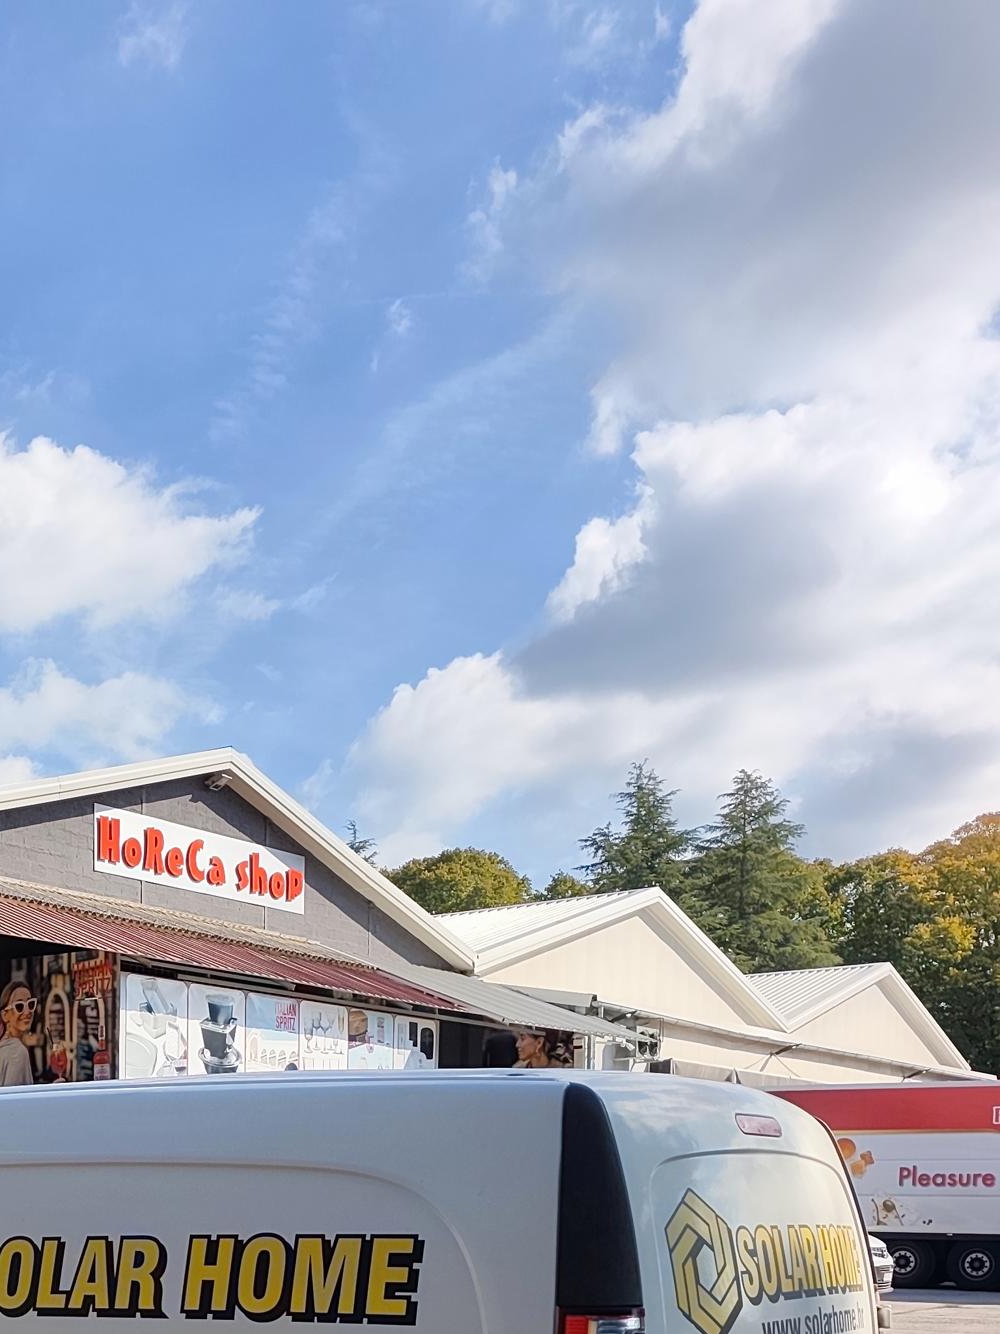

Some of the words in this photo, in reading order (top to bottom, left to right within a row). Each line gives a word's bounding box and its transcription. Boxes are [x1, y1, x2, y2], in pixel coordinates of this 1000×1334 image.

[97, 815, 224, 887] HoReCa
[236, 853, 304, 902] shop
[275, 1016, 296, 1030] SPRITZ
[898, 1165, 996, 1187] Pleasure
[179, 1233, 424, 1326] HOME
[735, 1224, 825, 1306] SOLAR
